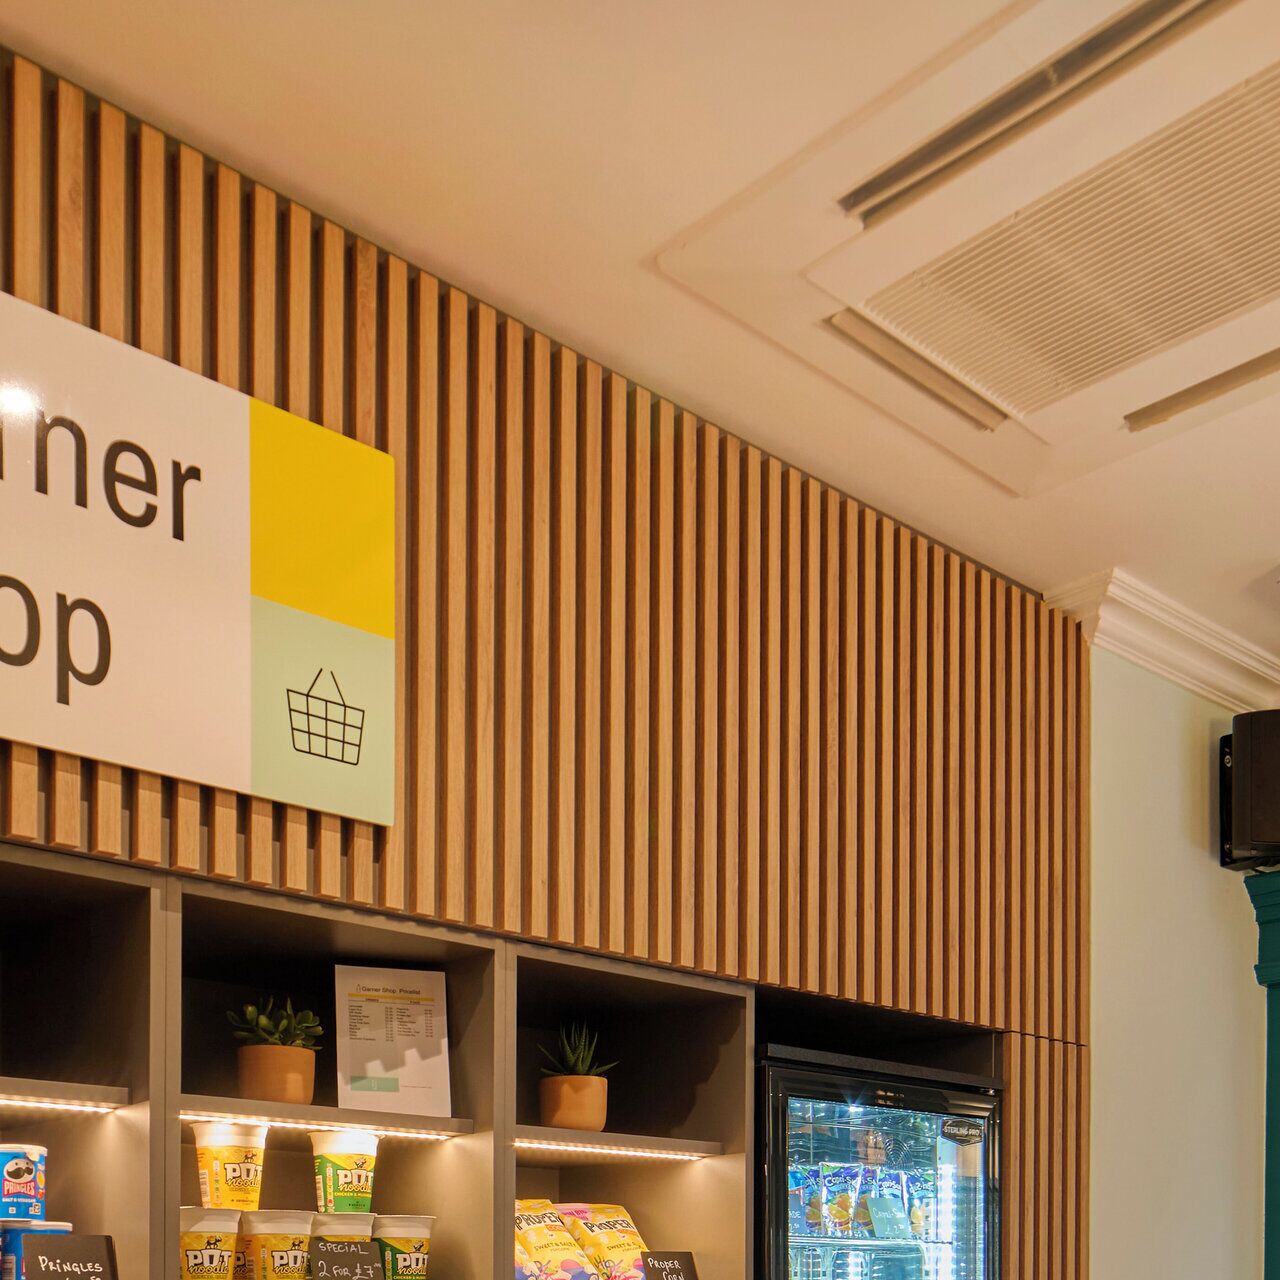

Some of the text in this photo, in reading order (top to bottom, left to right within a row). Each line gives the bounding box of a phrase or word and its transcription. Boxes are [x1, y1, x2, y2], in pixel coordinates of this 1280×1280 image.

[3, 1181, 35, 1197] PRINGLES
[583, 1219, 635, 1233] PROPER
[534, 1243, 556, 1251] SWEET
[186, 1249, 233, 1269] POT
[318, 1260, 331, 1277] 2
